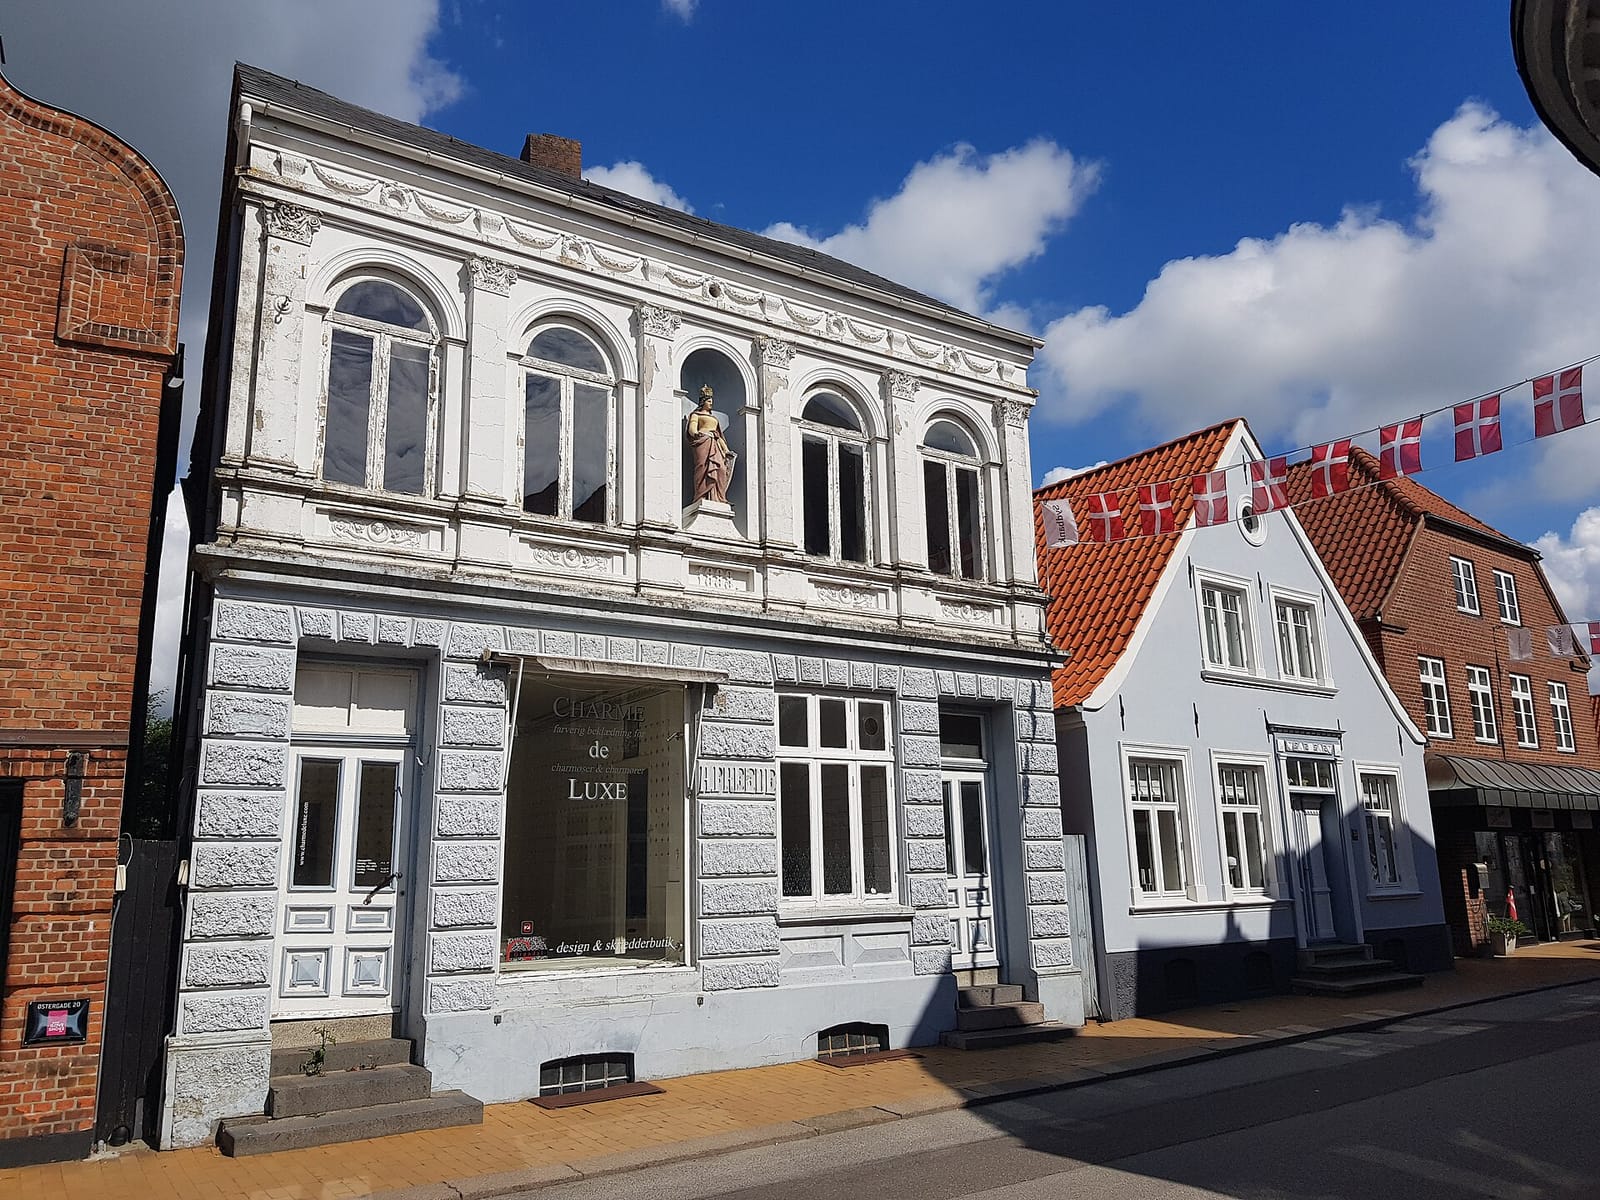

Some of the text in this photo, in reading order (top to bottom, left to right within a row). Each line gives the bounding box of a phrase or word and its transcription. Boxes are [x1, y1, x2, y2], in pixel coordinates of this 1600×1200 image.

[553, 696, 646, 722] CHARME
[589, 740, 609, 759] de
[567, 778, 627, 800] LUXE
[556, 941, 590, 955] design
[592, 939, 602, 952] &
